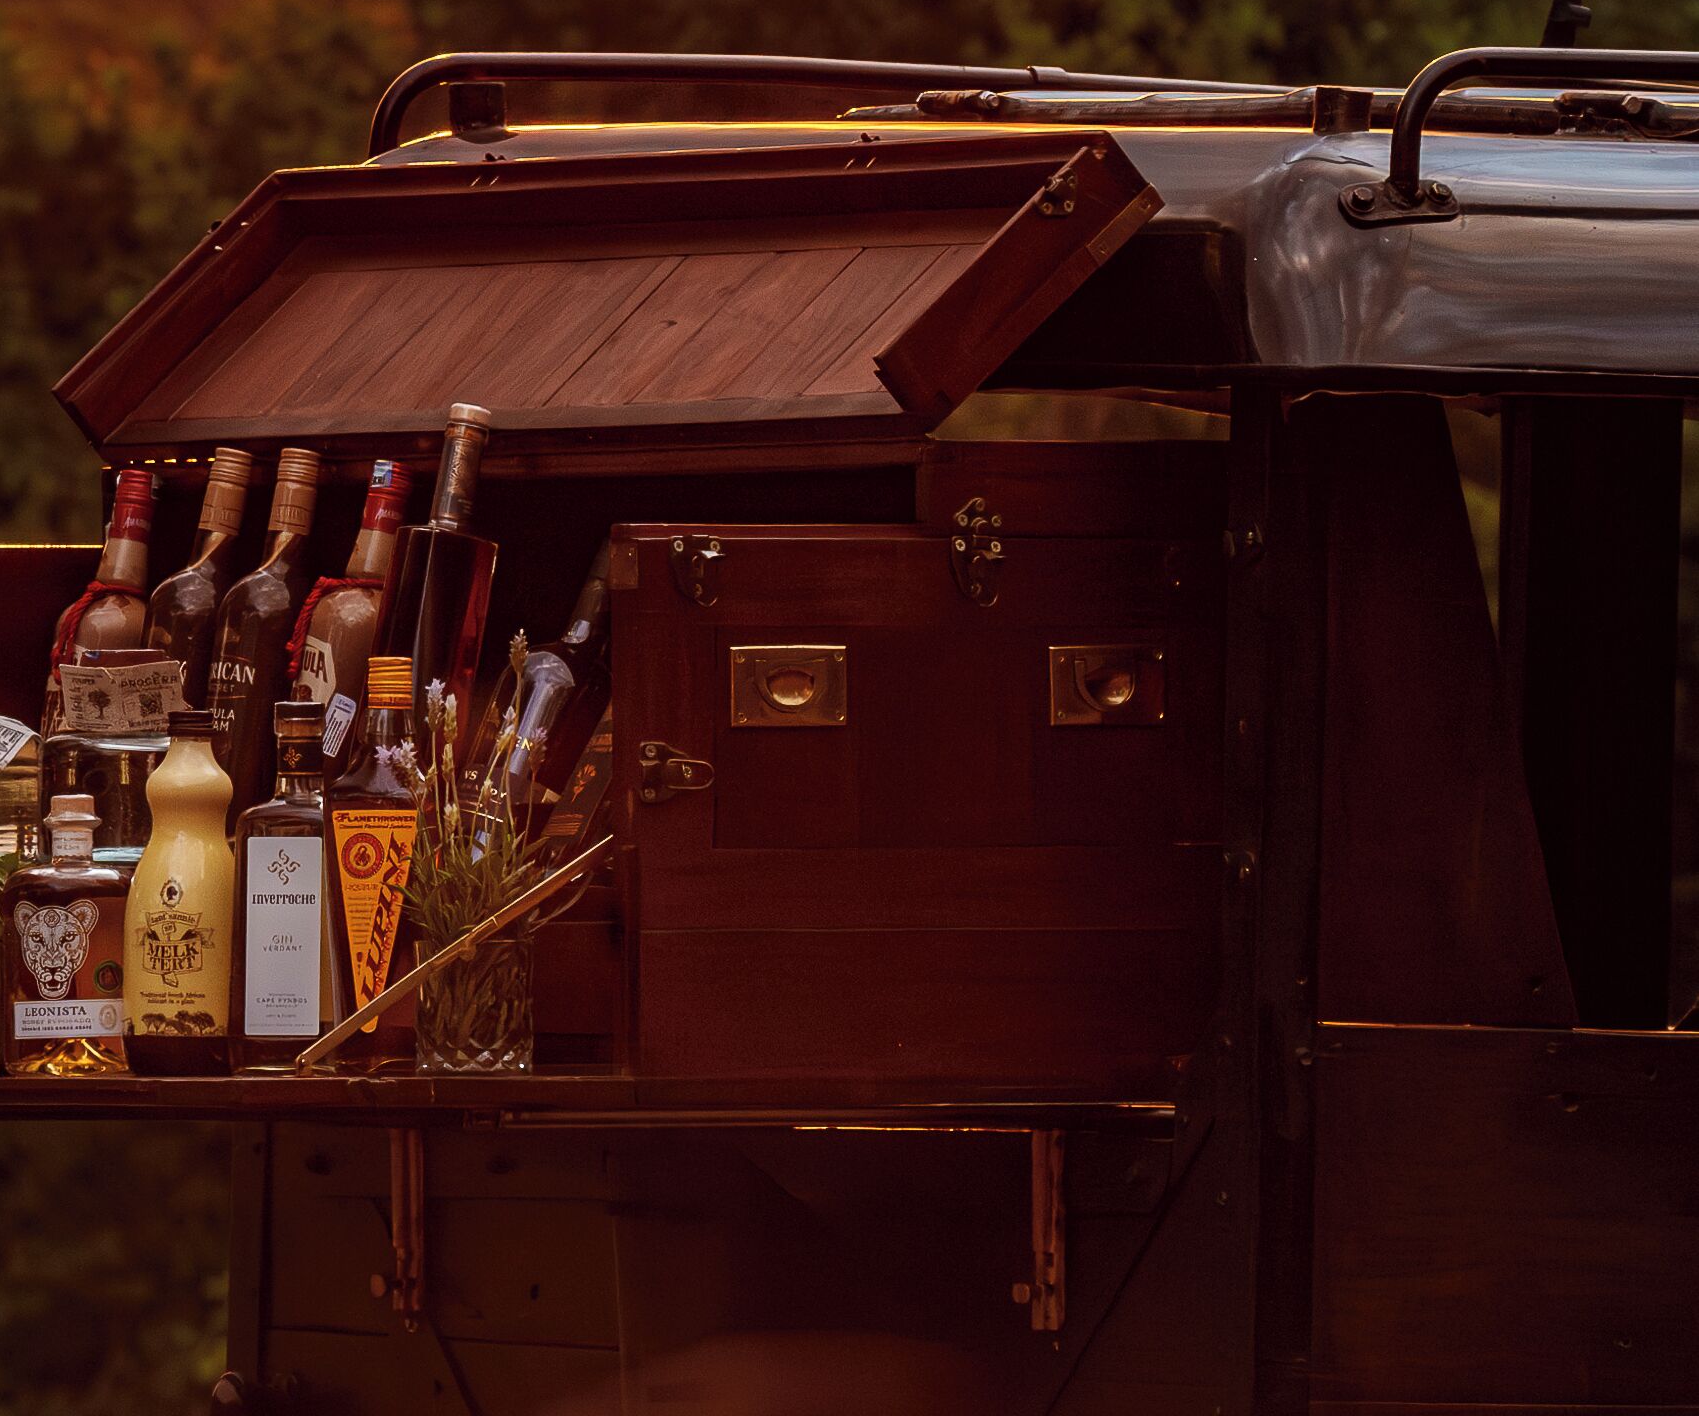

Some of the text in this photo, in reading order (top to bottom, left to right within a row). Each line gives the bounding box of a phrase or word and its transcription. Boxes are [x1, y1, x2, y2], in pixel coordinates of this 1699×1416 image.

[271, 934, 293, 944] GIN
[147, 942, 199, 959] MELK
[24, 1006, 87, 1017] LEONISTA
